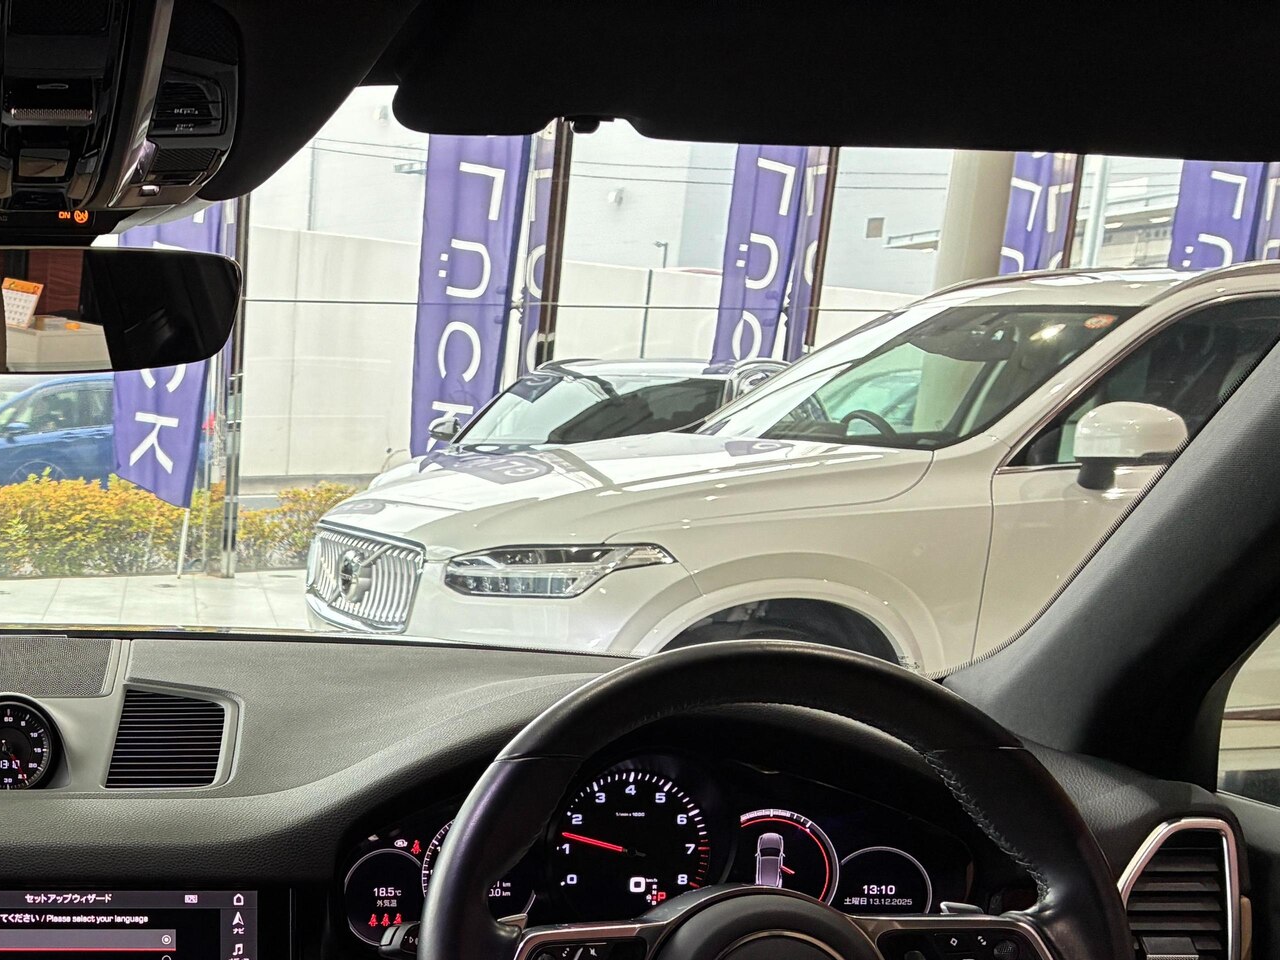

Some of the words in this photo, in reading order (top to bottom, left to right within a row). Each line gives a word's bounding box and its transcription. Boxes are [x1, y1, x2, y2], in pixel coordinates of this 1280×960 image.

[625, 785, 636, 795] 4
[596, 793, 606, 803] 3
[655, 793, 666, 803] 5
[572, 814, 582, 824] 2
[677, 815, 687, 825] 6
[562, 844, 570, 854] 1
[685, 844, 695, 854] 7
[567, 874, 577, 884] 0
[677, 874, 688, 885] 8
[630, 877, 645, 892] 0
[863, 885, 895, 894] 13:10
[25, 893, 112, 904] セットアップウィザード
[96, 916, 113, 924] your
[114, 915, 148, 924] language
